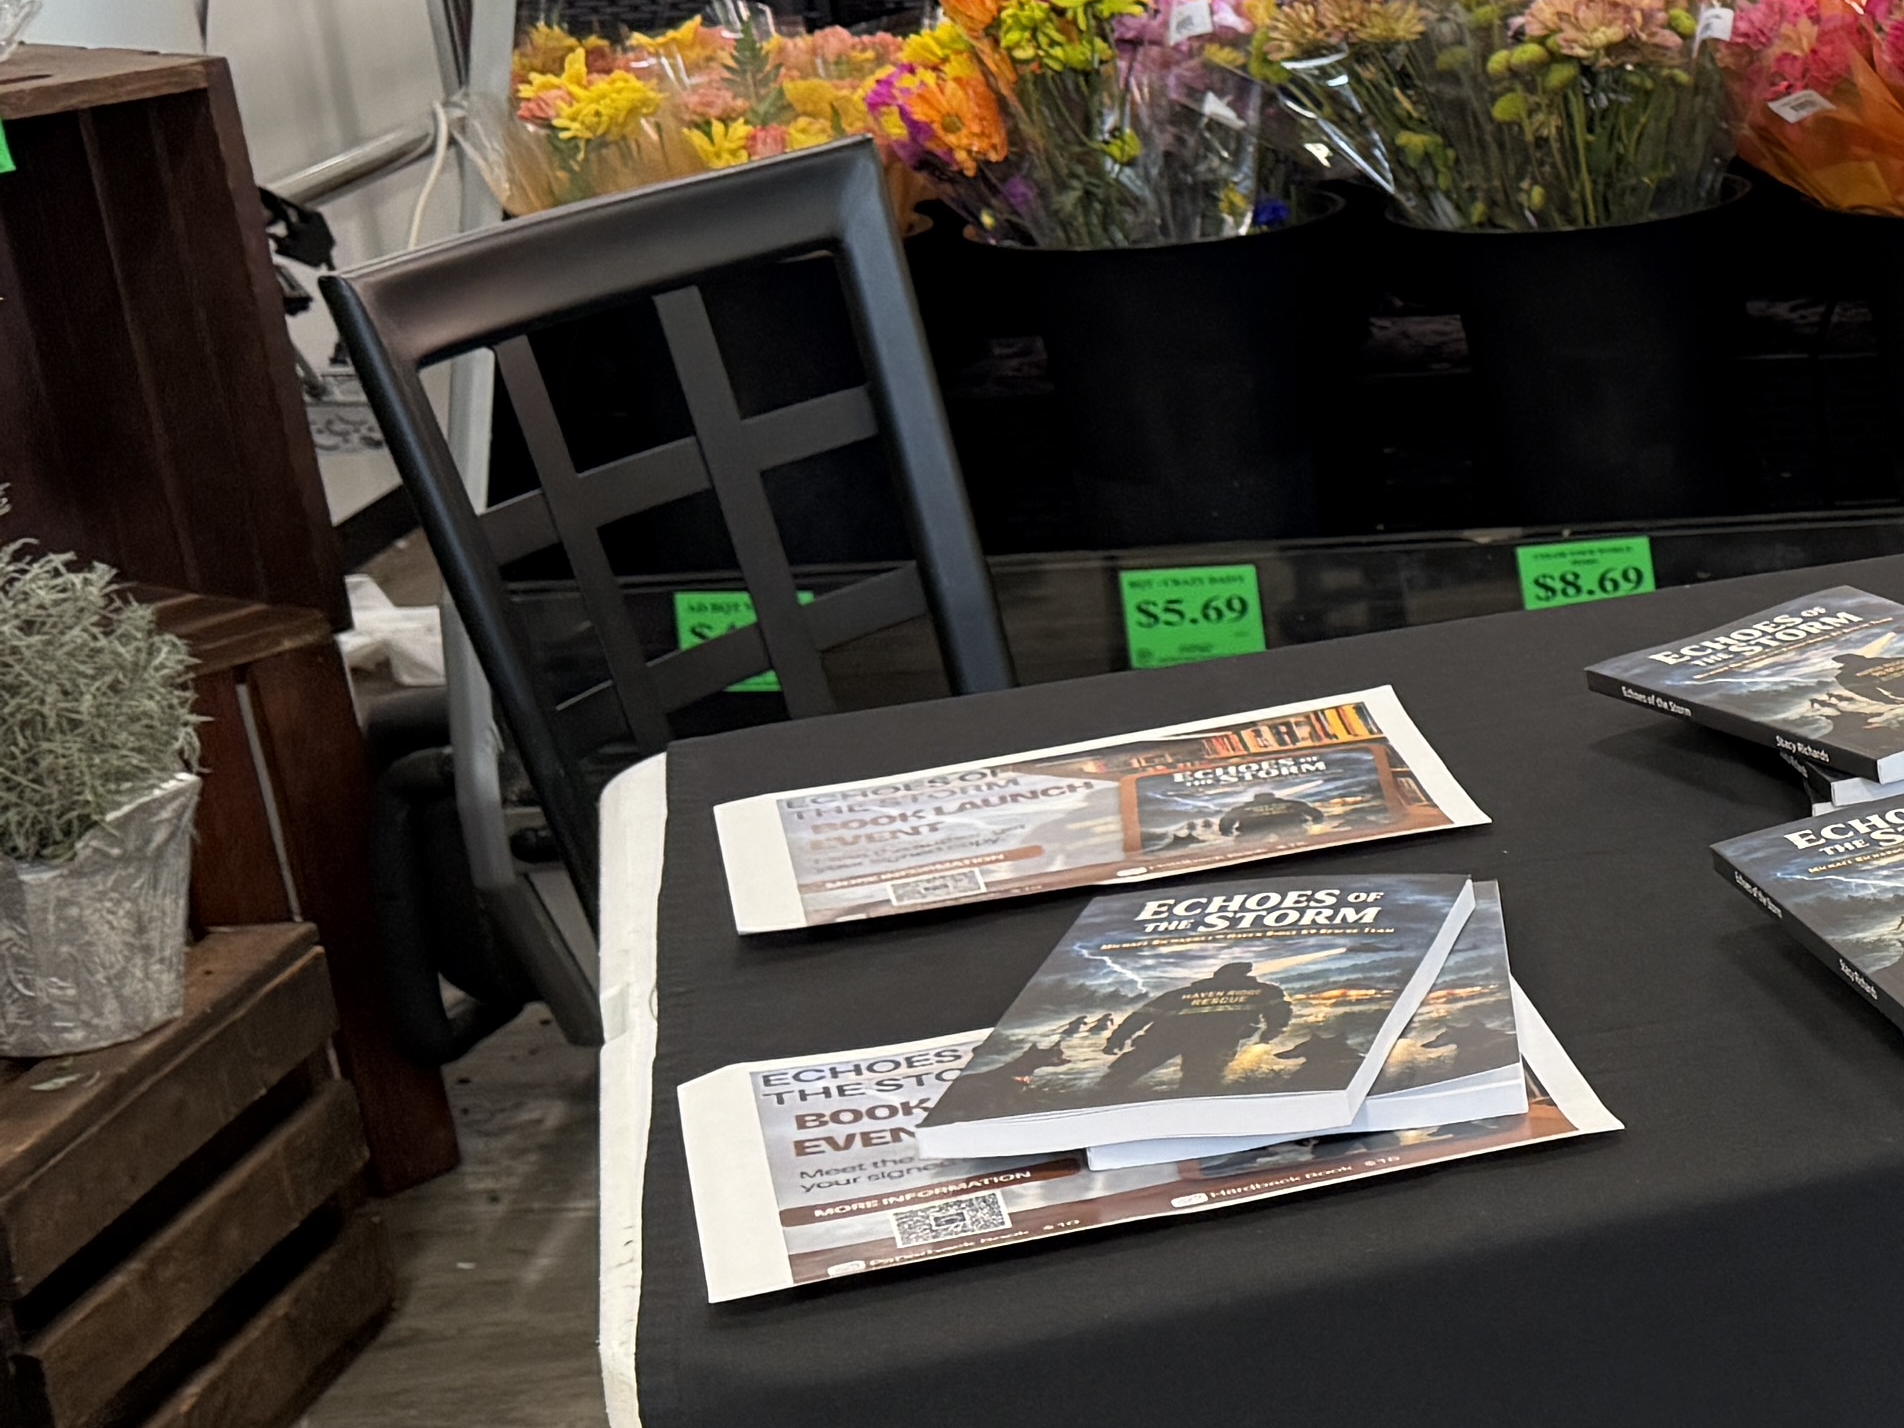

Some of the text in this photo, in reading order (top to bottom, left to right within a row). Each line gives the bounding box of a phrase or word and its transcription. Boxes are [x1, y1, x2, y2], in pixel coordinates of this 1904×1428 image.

[1533, 566, 1643, 602] $8.69
[1135, 594, 1249, 628] $5.69
[1648, 605, 1827, 665] ECHOES OF
[1691, 610, 1864, 668] THE STORM
[810, 780, 1094, 835] BOOK LAUNCH
[1818, 839, 1870, 857] THE
[1134, 889, 1384, 921] ECHOES OF
[1143, 906, 1382, 933] THE STORM
[761, 1047, 966, 1088] ECHOES
[794, 1097, 932, 1131] BOOK
[814, 1170, 1031, 1218] MORE INFORMATION
